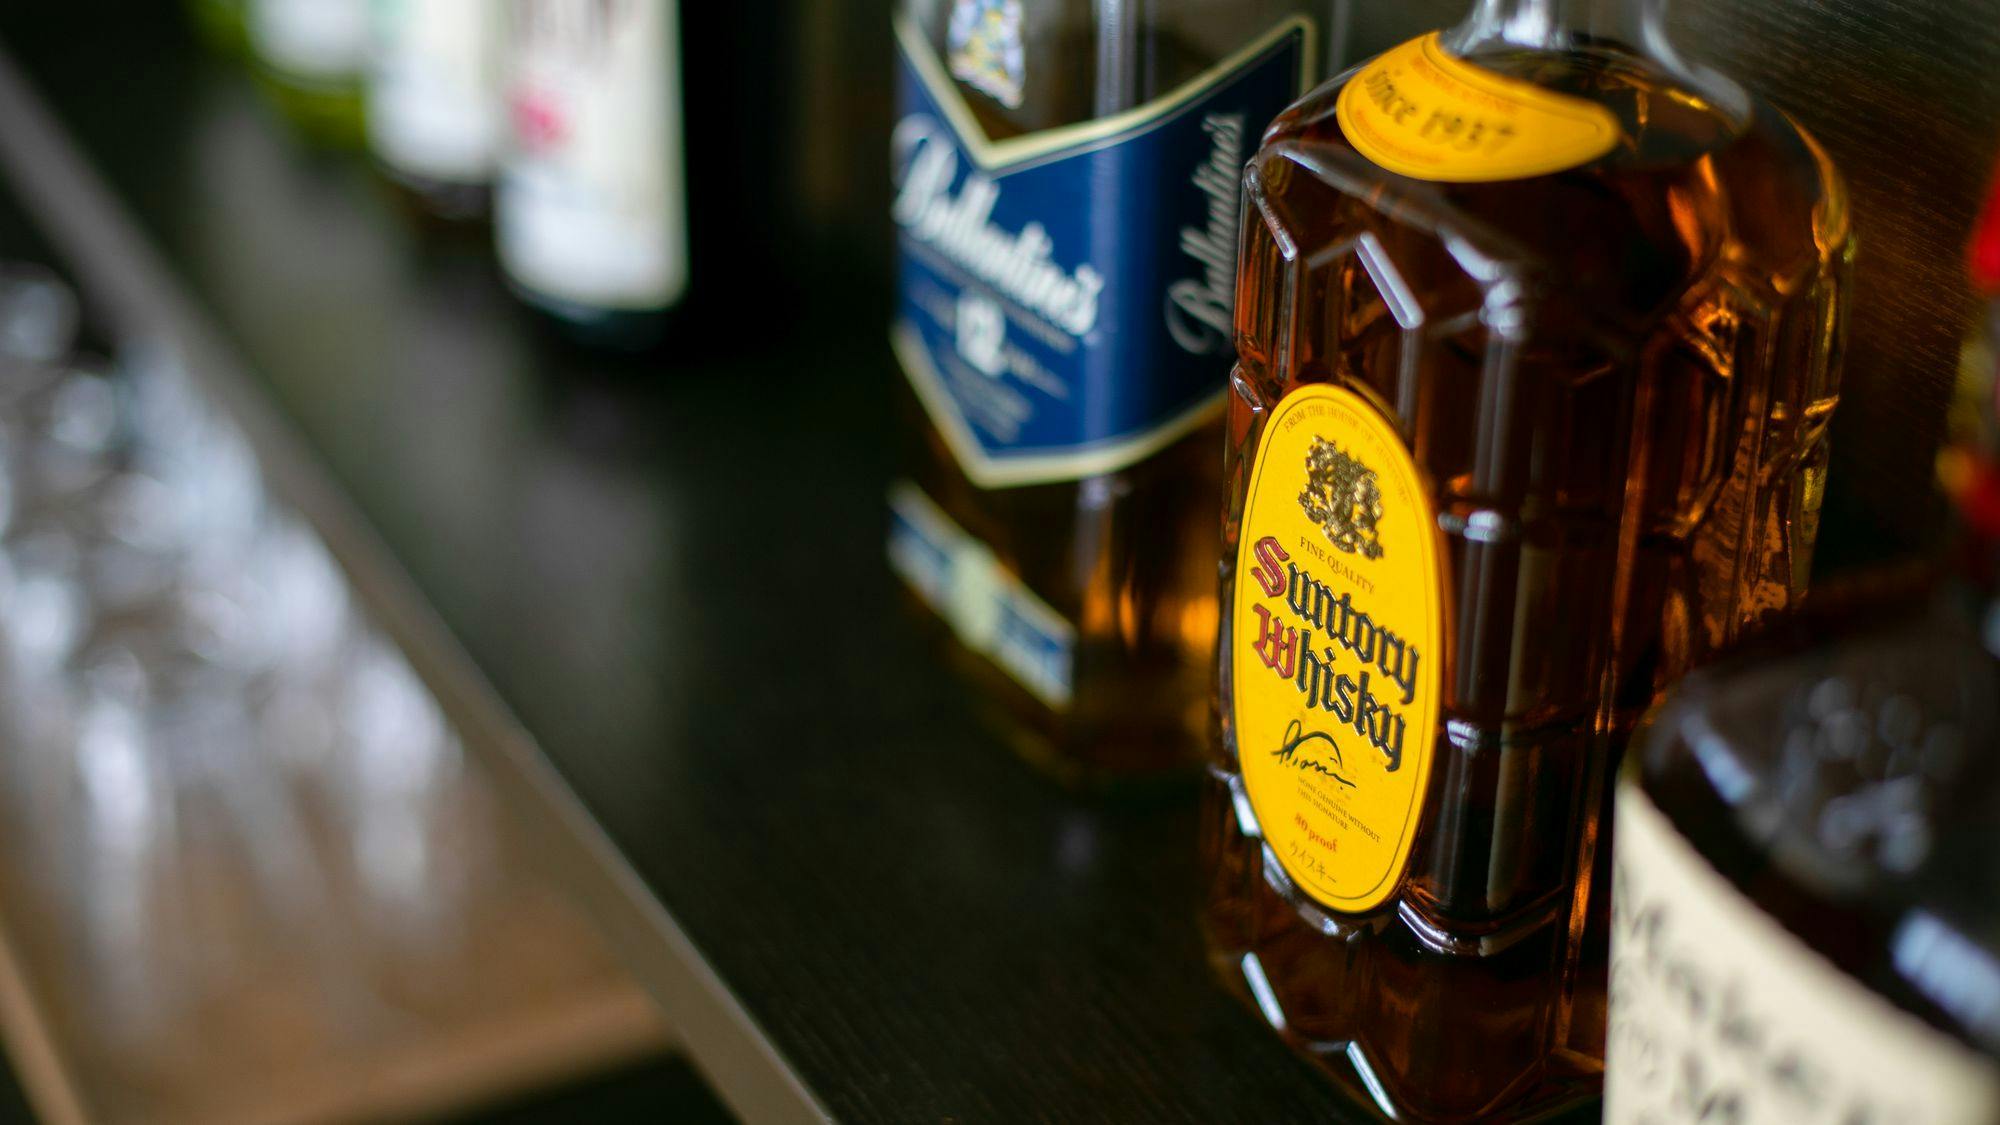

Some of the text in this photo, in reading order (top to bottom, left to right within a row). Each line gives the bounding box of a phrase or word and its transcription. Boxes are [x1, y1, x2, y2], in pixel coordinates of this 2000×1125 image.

[1284, 408, 1306, 432] FROM
[1308, 404, 1324, 416] THE
[1300, 536, 1375, 595] FINE QUALITY
[1250, 536, 1419, 706] Suntory
[1252, 603, 1406, 773] Whisky
[1308, 829, 1338, 853] proof
[1313, 799, 1348, 831] SIGNATURE
[1317, 790, 1348, 818] GENUINE
[1348, 813, 1380, 843] WITHOUT
